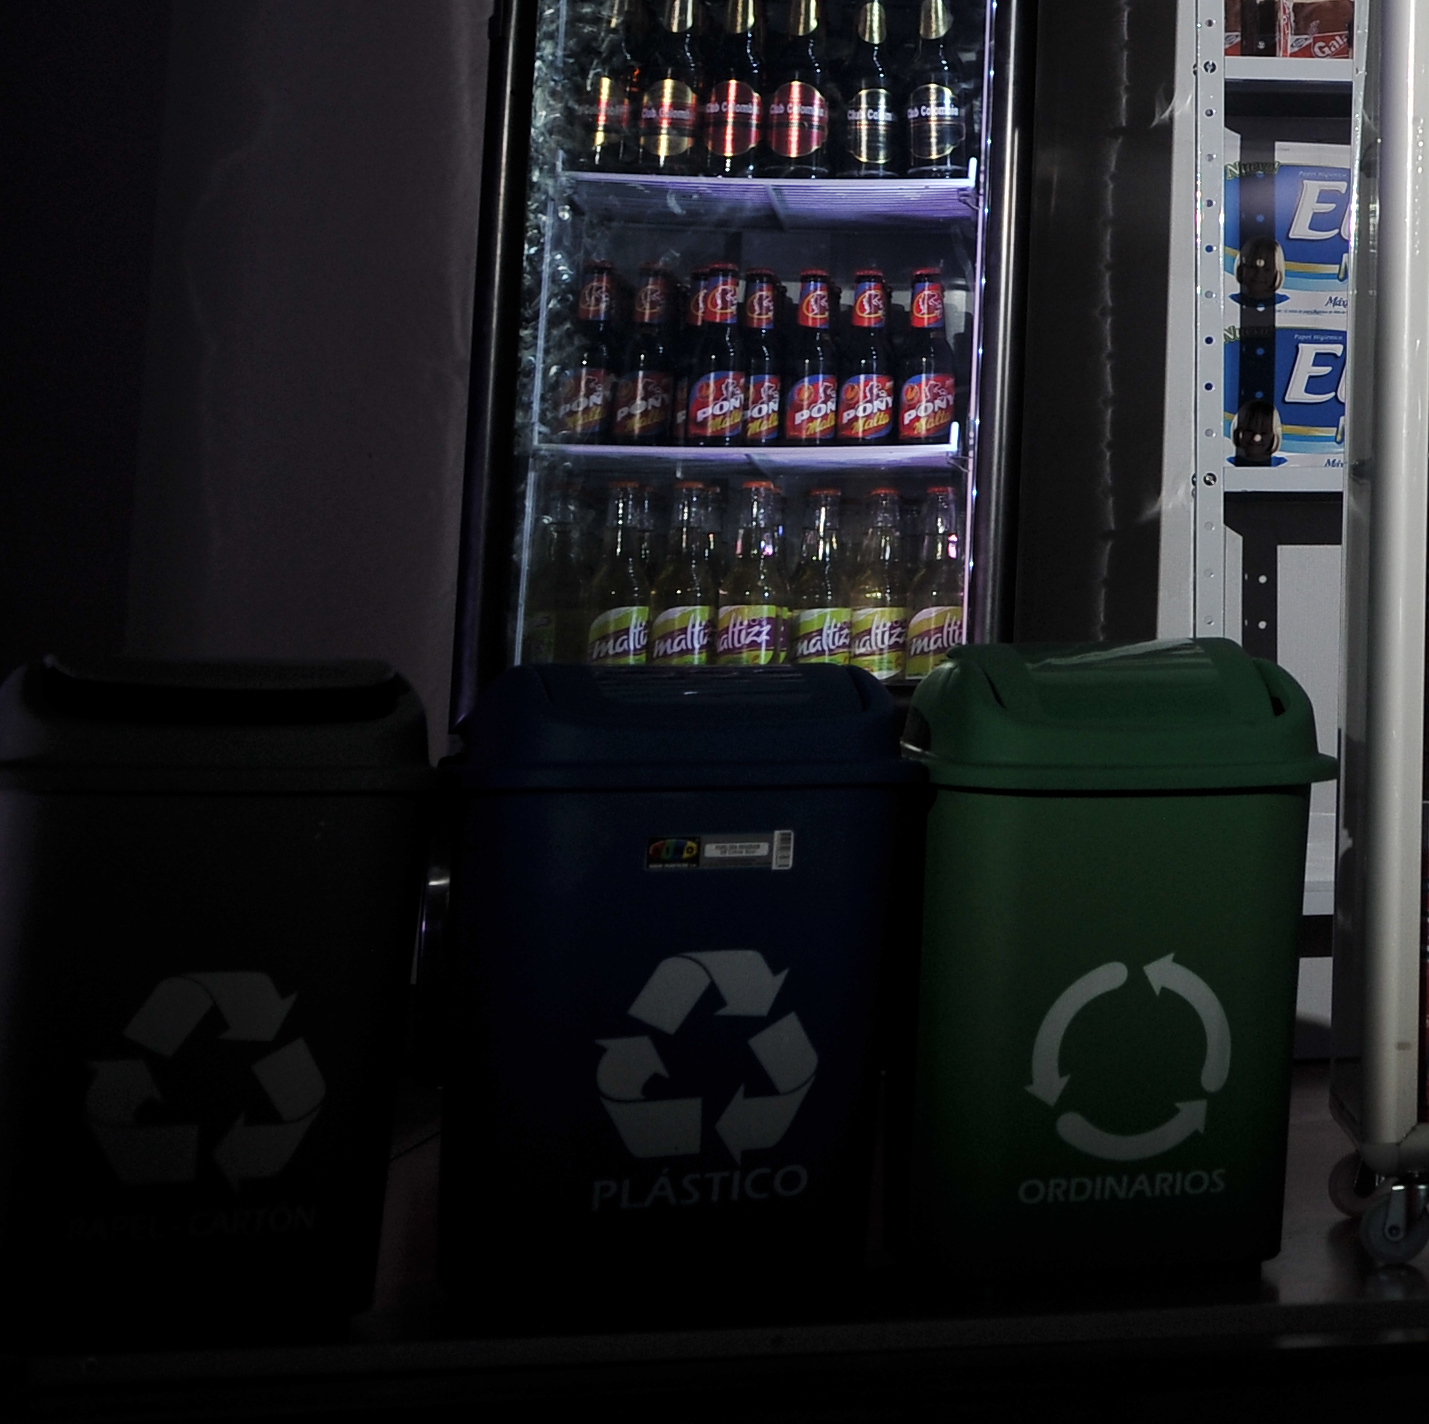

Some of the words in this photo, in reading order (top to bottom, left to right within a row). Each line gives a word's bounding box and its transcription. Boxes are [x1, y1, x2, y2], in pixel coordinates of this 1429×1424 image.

[840, 394, 892, 422] PONY
[591, 1162, 810, 1213] PLÁSTICO
[1018, 1167, 1229, 1206] ORDINARIOS
